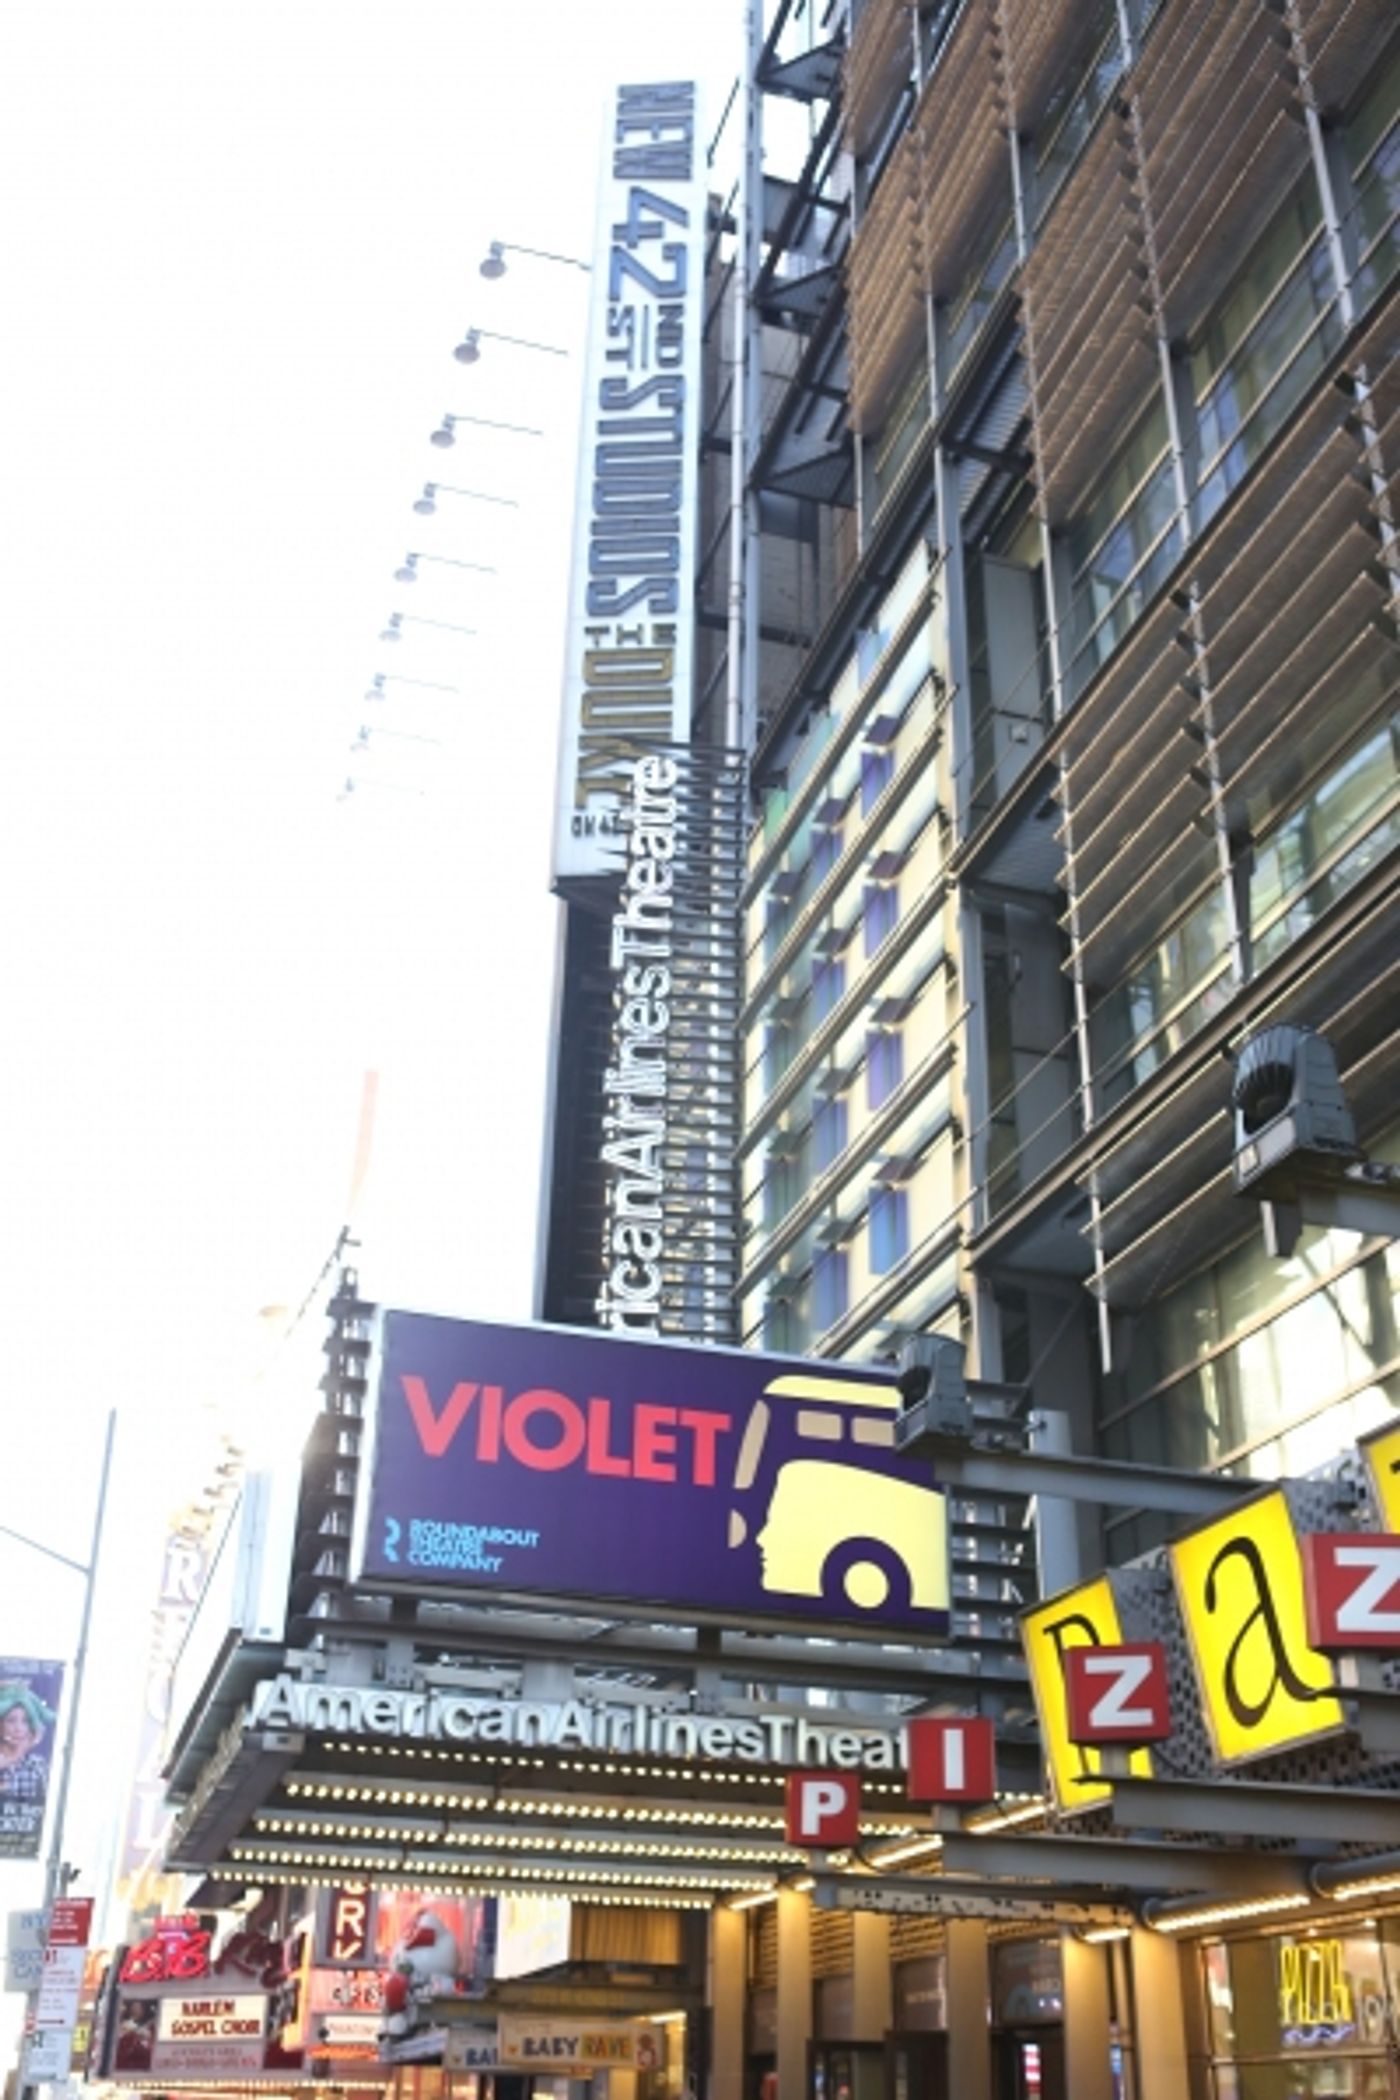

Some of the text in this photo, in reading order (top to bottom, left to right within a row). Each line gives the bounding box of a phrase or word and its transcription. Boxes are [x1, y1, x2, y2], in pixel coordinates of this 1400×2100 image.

[613, 80, 695, 181] NEW
[608, 185, 689, 302] 42
[585, 374, 686, 618] STUDIOS
[594, 754, 678, 1338] ricanAirlinesTheatre
[400, 1374, 732, 1487] VIOLET
[406, 1549, 504, 1573] COMPANY
[409, 1518, 541, 1548] ROUNDABOUT
[257, 1672, 909, 1770] AmericanAirlinesTheat
[171, 2018, 261, 2036] GOSPEL CHOIR
[181, 2000, 236, 2017] HARLEM
[522, 2036, 580, 2057] BABY
